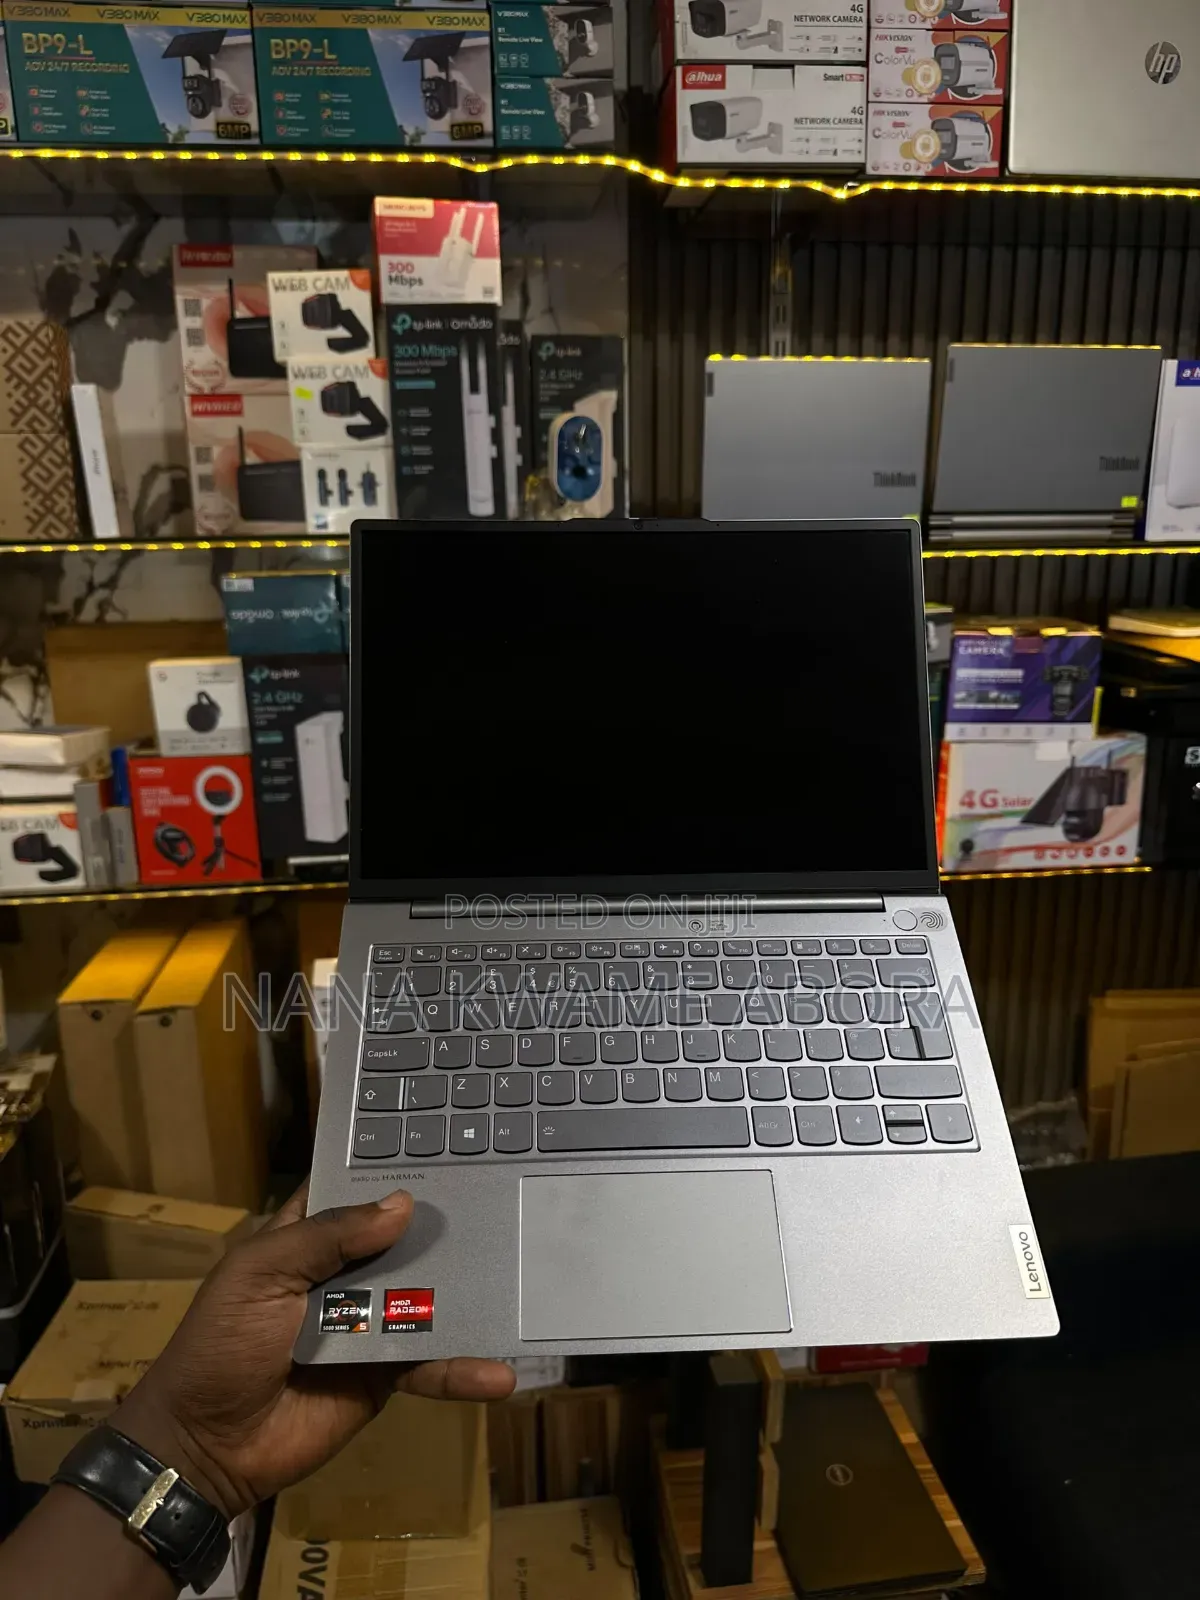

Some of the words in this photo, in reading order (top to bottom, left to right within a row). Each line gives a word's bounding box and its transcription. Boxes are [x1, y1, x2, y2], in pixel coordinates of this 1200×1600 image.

[850, 4, 864, 13] 4G
[793, 14, 831, 23] NETWORK
[832, 15, 863, 23] CAMERA
[22, 33, 94, 55] BP9-L
[270, 38, 338, 60] BP9-L
[1146, 41, 1180, 84] hp
[850, 106, 864, 115] 4G
[793, 117, 831, 125] NETWORK
[832, 117, 863, 125] CAMERA
[387, 261, 415, 274] 300
[271, 277, 308, 293] WEB
[312, 276, 350, 291] CAM
[387, 274, 424, 289] Mbps
[420, 344, 458, 358] Mbps
[291, 365, 327, 380] WEB
[332, 364, 369, 379] CAM
[22, 817, 60, 831] CAM
[489, 980, 497, 990] 3
[568, 978, 577, 988] 5
[608, 976, 616, 987] 6
[647, 976, 655, 986] 7
[687, 975, 695, 985] 8
[726, 975, 734, 985] 9
[449, 981, 457, 991] 2
[468, 1003, 482, 1013] W
[508, 1002, 517, 1012] E
[549, 1001, 558, 1011] R
[630, 999, 639, 1009] Y
[669, 998, 678, 1009] U
[427, 1004, 438, 1015] Q
[480, 1038, 490, 1050] S
[522, 1037, 532, 1049] D
[563, 1036, 572, 1047] F
[604, 1035, 615, 1046] G
[645, 1034, 655, 1045] H
[686, 1034, 694, 1045] J
[727, 1033, 737, 1044] K
[767, 1033, 776, 1044] L
[438, 1040, 449, 1051] A
[367, 1049, 398, 1059] CapsLk
[499, 1076, 509, 1088] X
[541, 1075, 552, 1087] C
[584, 1074, 594, 1085] V
[625, 1073, 635, 1084] B
[667, 1072, 678, 1083] N
[709, 1071, 721, 1082] M
[456, 1078, 467, 1090] Z
[359, 1133, 375, 1142] Ctrl
[410, 1131, 421, 1139] Fn
[498, 1128, 510, 1136] Alt
[382, 1172, 425, 1181] HARMAN
[1018, 1231, 1042, 1292] Lenovo
[328, 1306, 365, 1317] RYZEN
[389, 1306, 429, 1314] RADEON
